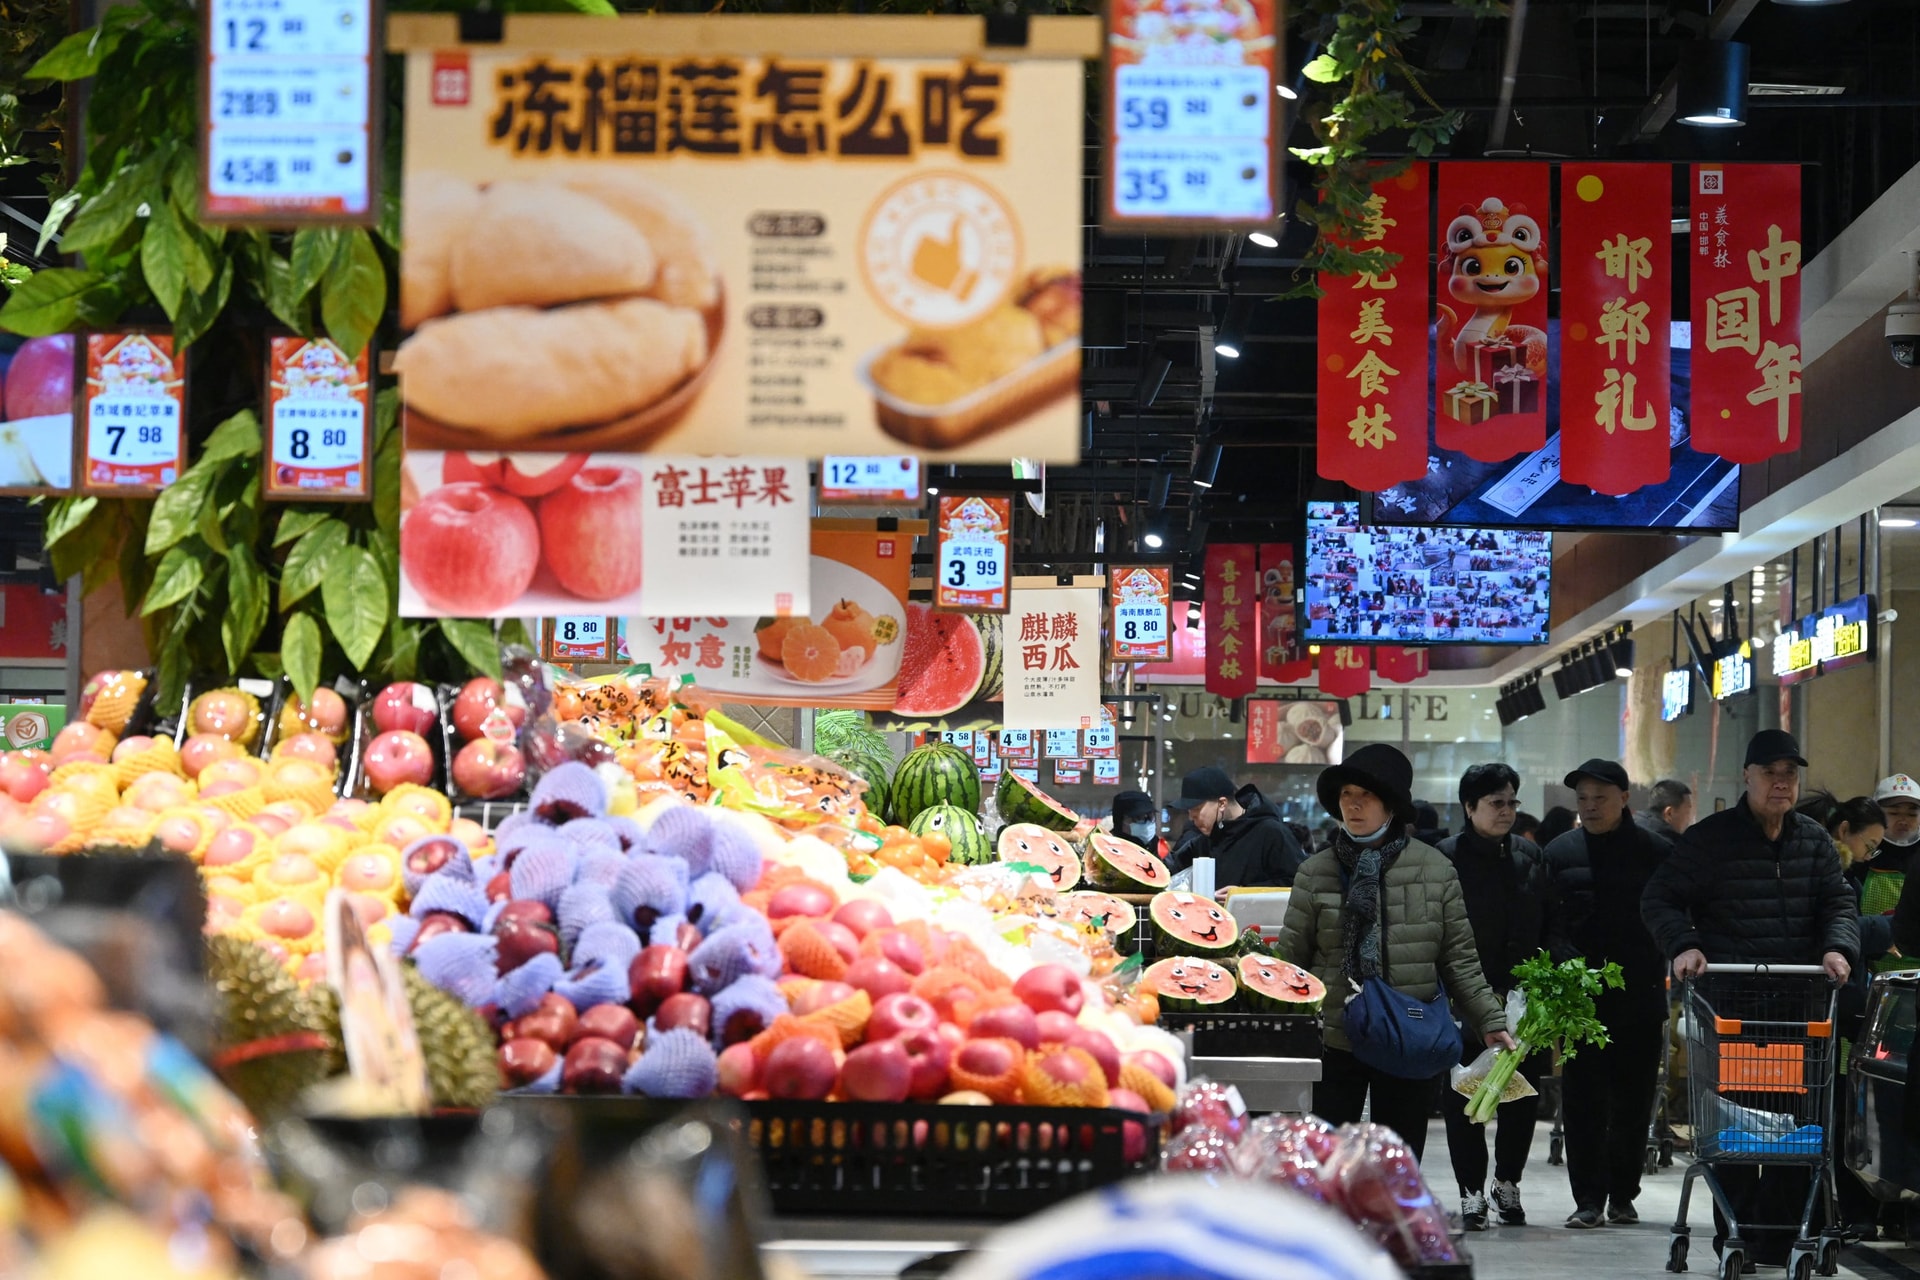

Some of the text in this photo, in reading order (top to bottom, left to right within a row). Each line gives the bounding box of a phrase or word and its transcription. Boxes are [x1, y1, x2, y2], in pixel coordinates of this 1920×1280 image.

[226, 18, 266, 49] 12
[221, 89, 279, 115] 289
[493, 60, 1004, 161] 冻榴莲怎么吃
[1125, 97, 1169, 129] 59
[222, 158, 279, 184] 458
[1124, 169, 1168, 201] 35
[1594, 233, 1657, 435] 邯郸礼
[1705, 223, 1801, 444] 中国年
[653, 465, 793, 510] 富士苹果
[832, 464, 857, 484] 12
[952, 546, 993, 557] 武鸣沃柑
[1018, 611, 1079, 642] 麒麟
[1120, 608, 1162, 617] 海南麒麟瓜
[1218, 558, 1243, 681] 喜见美食林
[659, 631, 726, 669] 如意
[1022, 642, 1081, 672] 西瓜
[1357, 693, 1448, 721] LIFE
